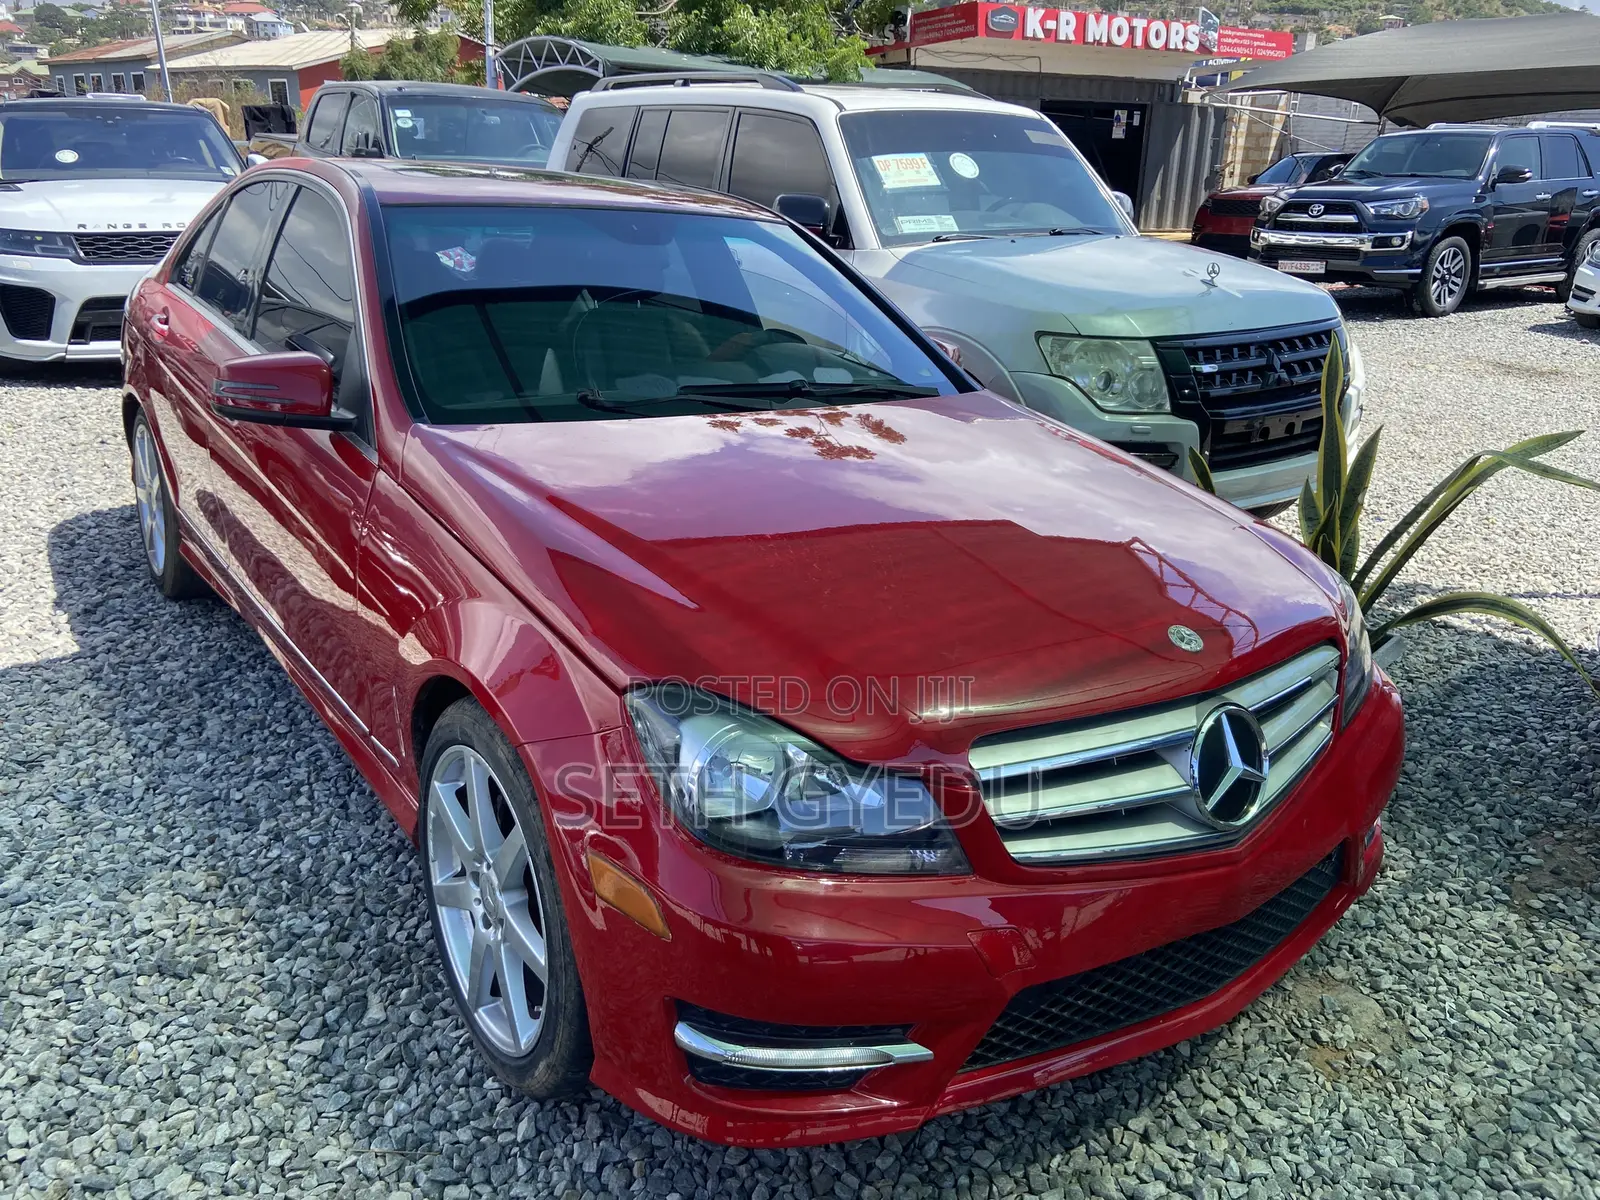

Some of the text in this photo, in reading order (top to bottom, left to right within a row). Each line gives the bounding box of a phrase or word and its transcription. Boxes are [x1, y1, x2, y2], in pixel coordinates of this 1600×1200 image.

[1025, 6, 1200, 53] K-R MOTORS
[892, 158, 921, 171] 7599
[920, 157, 928, 169] F
[77, 222, 148, 230] RANGE
